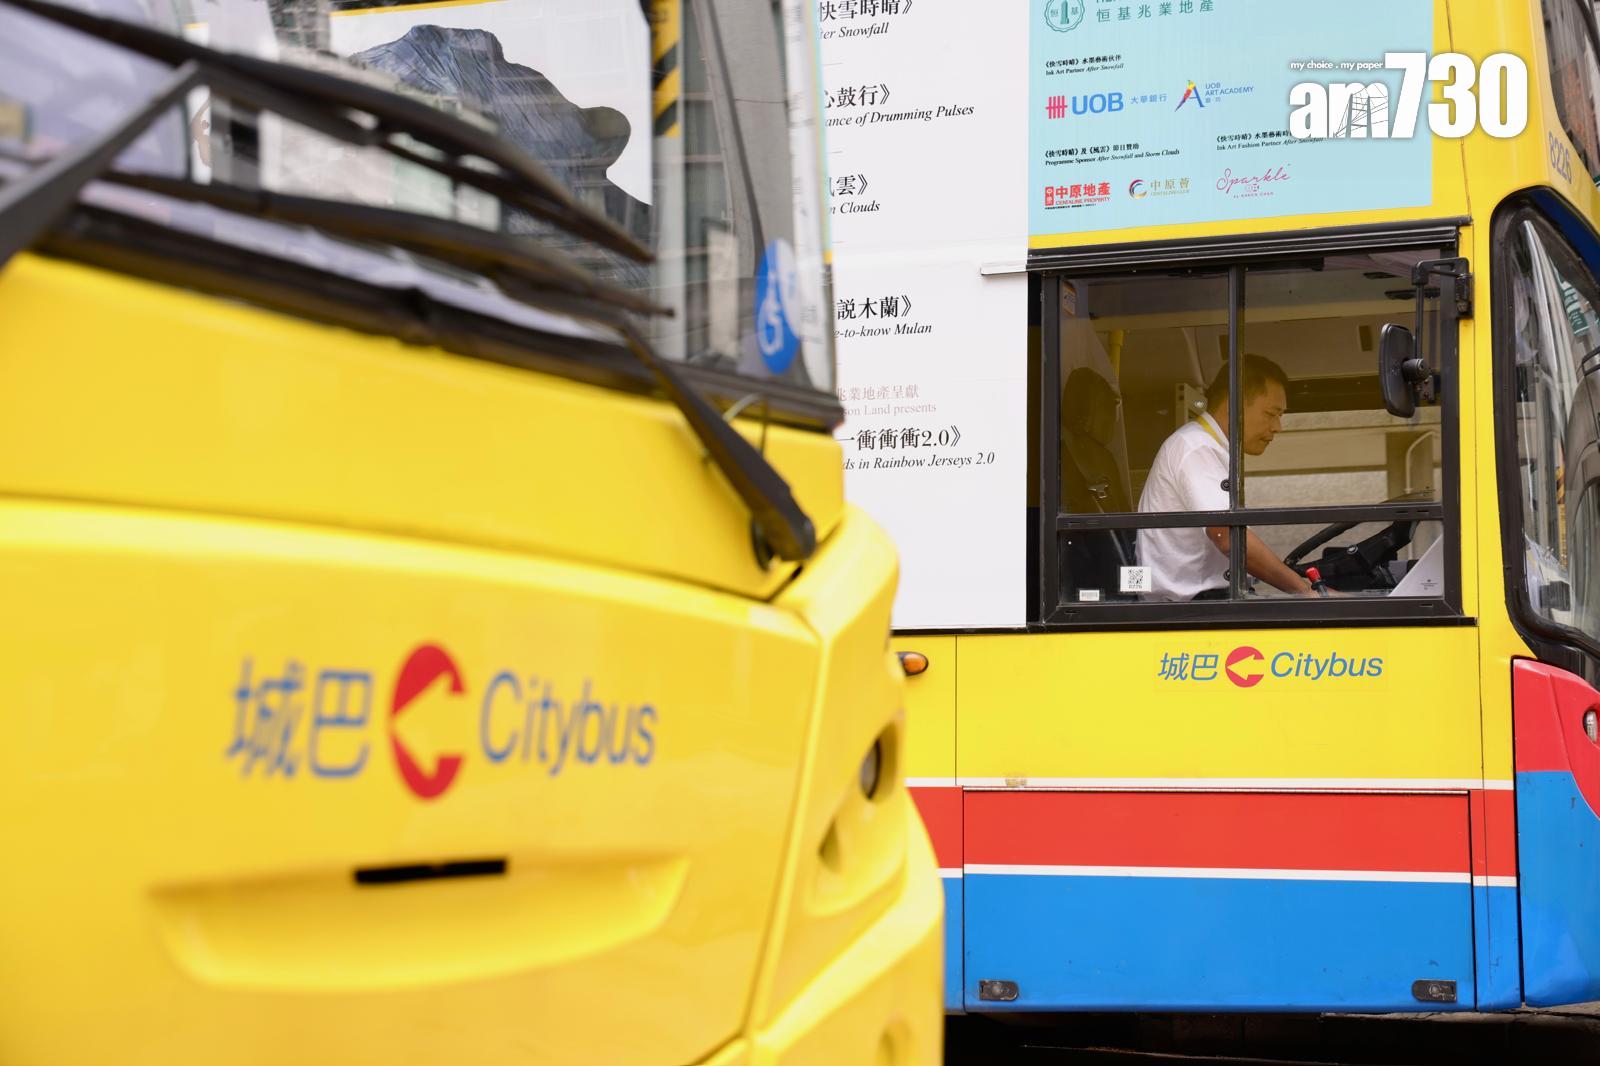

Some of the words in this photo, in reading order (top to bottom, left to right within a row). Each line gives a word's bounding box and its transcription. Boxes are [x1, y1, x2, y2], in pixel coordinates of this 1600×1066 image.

[838, 22, 889, 38] Snowfall
[1204, 89, 1219, 97] ART
[1219, 86, 1254, 96] ACADEMY
[1205, 82, 1221, 90] UOB
[1071, 92, 1124, 116] UOB
[855, 112, 870, 127] of
[870, 108, 933, 123] Drumming
[936, 104, 975, 118] Pulses
[1055, 181, 1111, 199] 中原地產
[840, 200, 881, 214] Clouds
[894, 322, 933, 336] Mulan
[863, 404, 891, 416] Land
[893, 403, 937, 418] presents
[858, 456, 870, 470] in
[873, 455, 926, 470] Rainbow
[927, 453, 973, 470] Jerseys
[975, 451, 996, 466] 2.0
[1158, 651, 1220, 682] 城巴
[1270, 650, 1384, 682] Citybus
[224, 656, 376, 780] 城巴
[479, 669, 658, 778] Citybus
